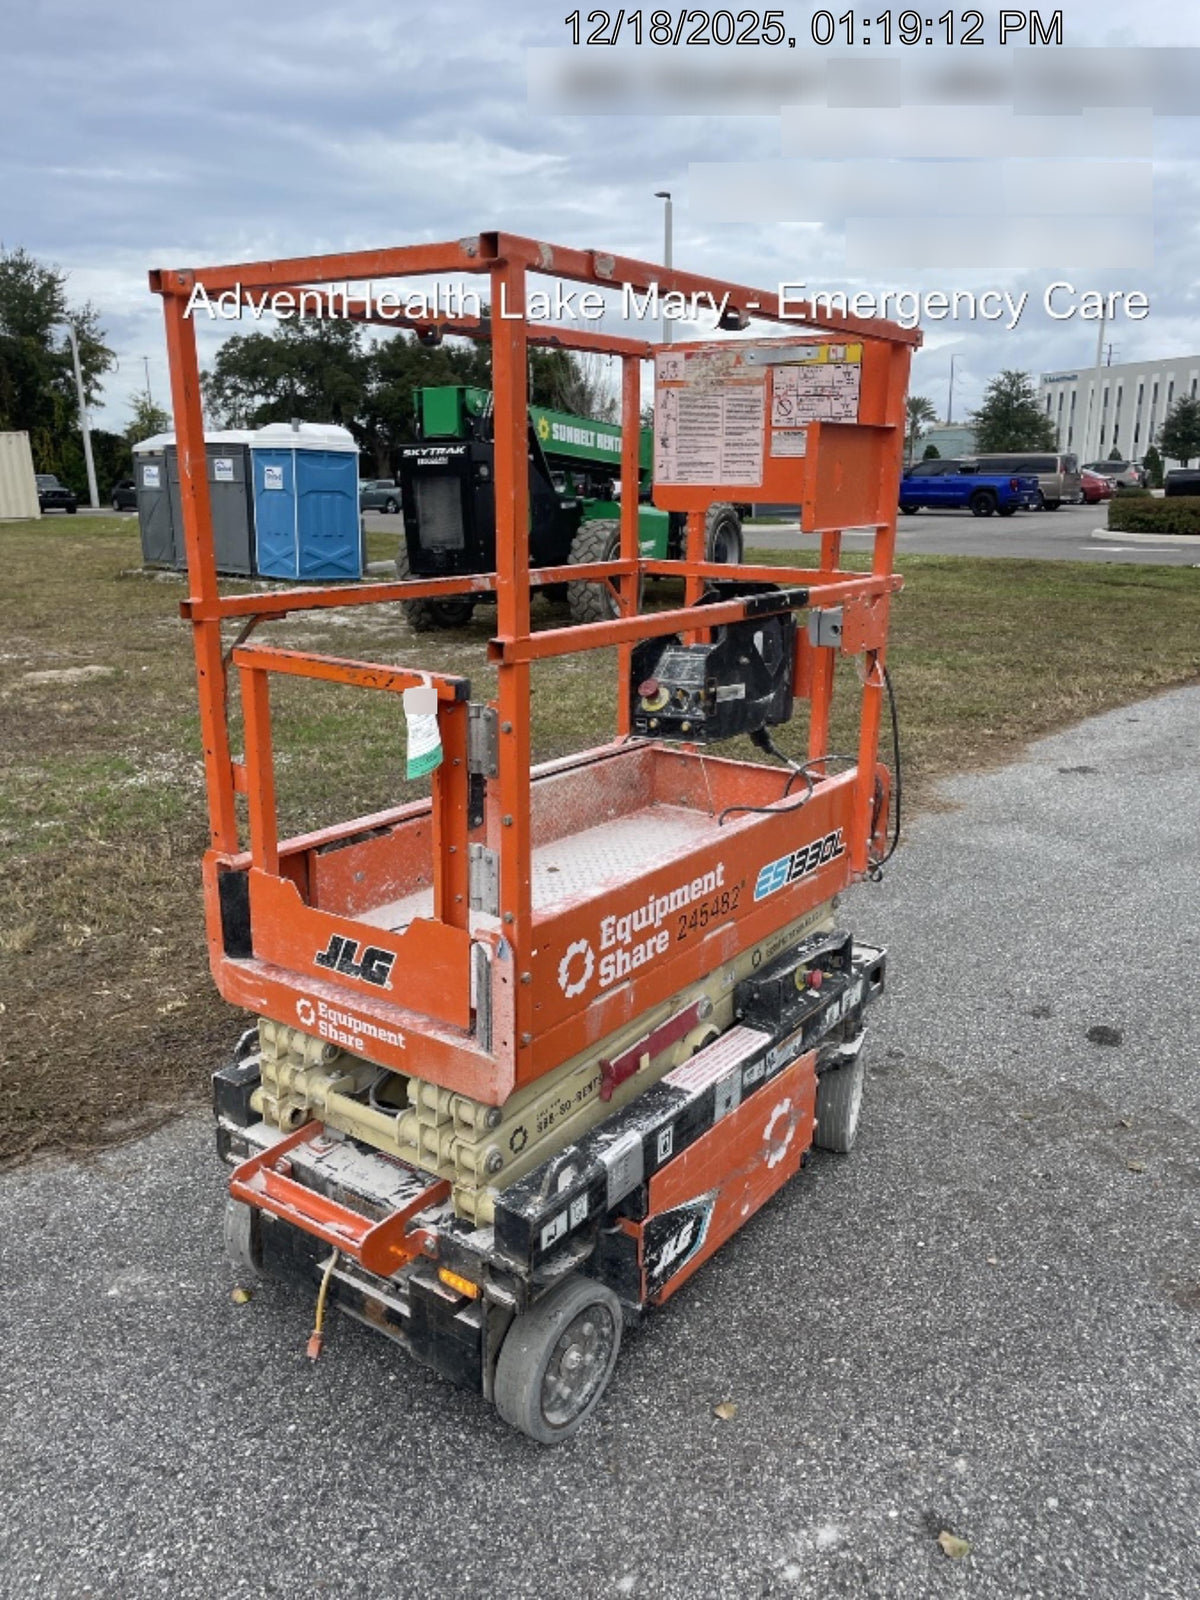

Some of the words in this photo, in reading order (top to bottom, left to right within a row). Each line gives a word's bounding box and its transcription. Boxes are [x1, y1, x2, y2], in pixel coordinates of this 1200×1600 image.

[402, 446, 467, 457] SKYTRAK
[552, 422, 596, 447] SUNBELT
[754, 827, 847, 902] ES1330L
[600, 862, 725, 951] Equipment
[677, 886, 741, 941] 245482
[314, 933, 397, 988] JLG
[599, 928, 669, 987] Share
[318, 1001, 406, 1049] Equipment
[319, 1020, 364, 1051] Share
